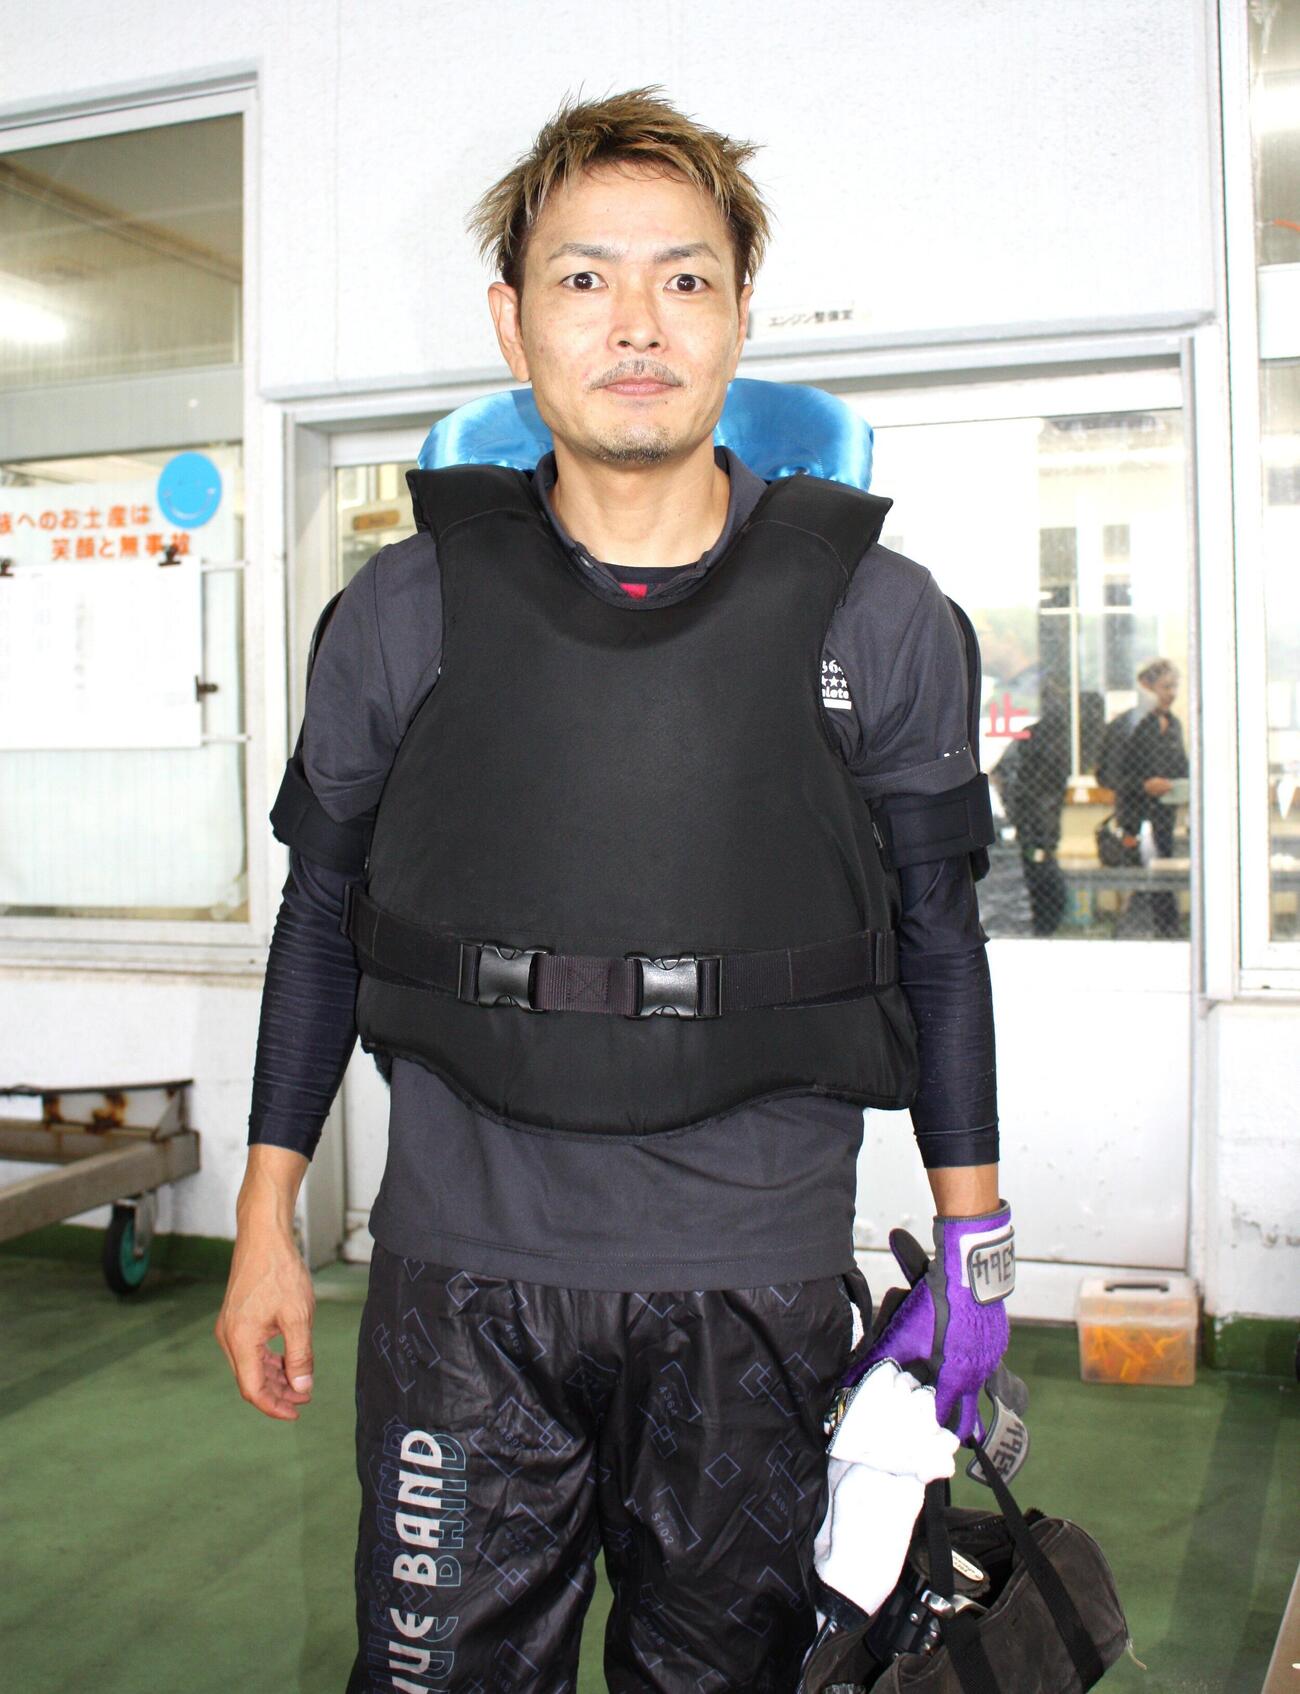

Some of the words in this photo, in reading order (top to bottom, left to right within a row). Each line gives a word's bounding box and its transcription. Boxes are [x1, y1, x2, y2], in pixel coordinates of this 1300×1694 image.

[986, 693, 1030, 739] 止
[393, 1430, 466, 1587] BAND
[651, 1512, 674, 1545] 5102
